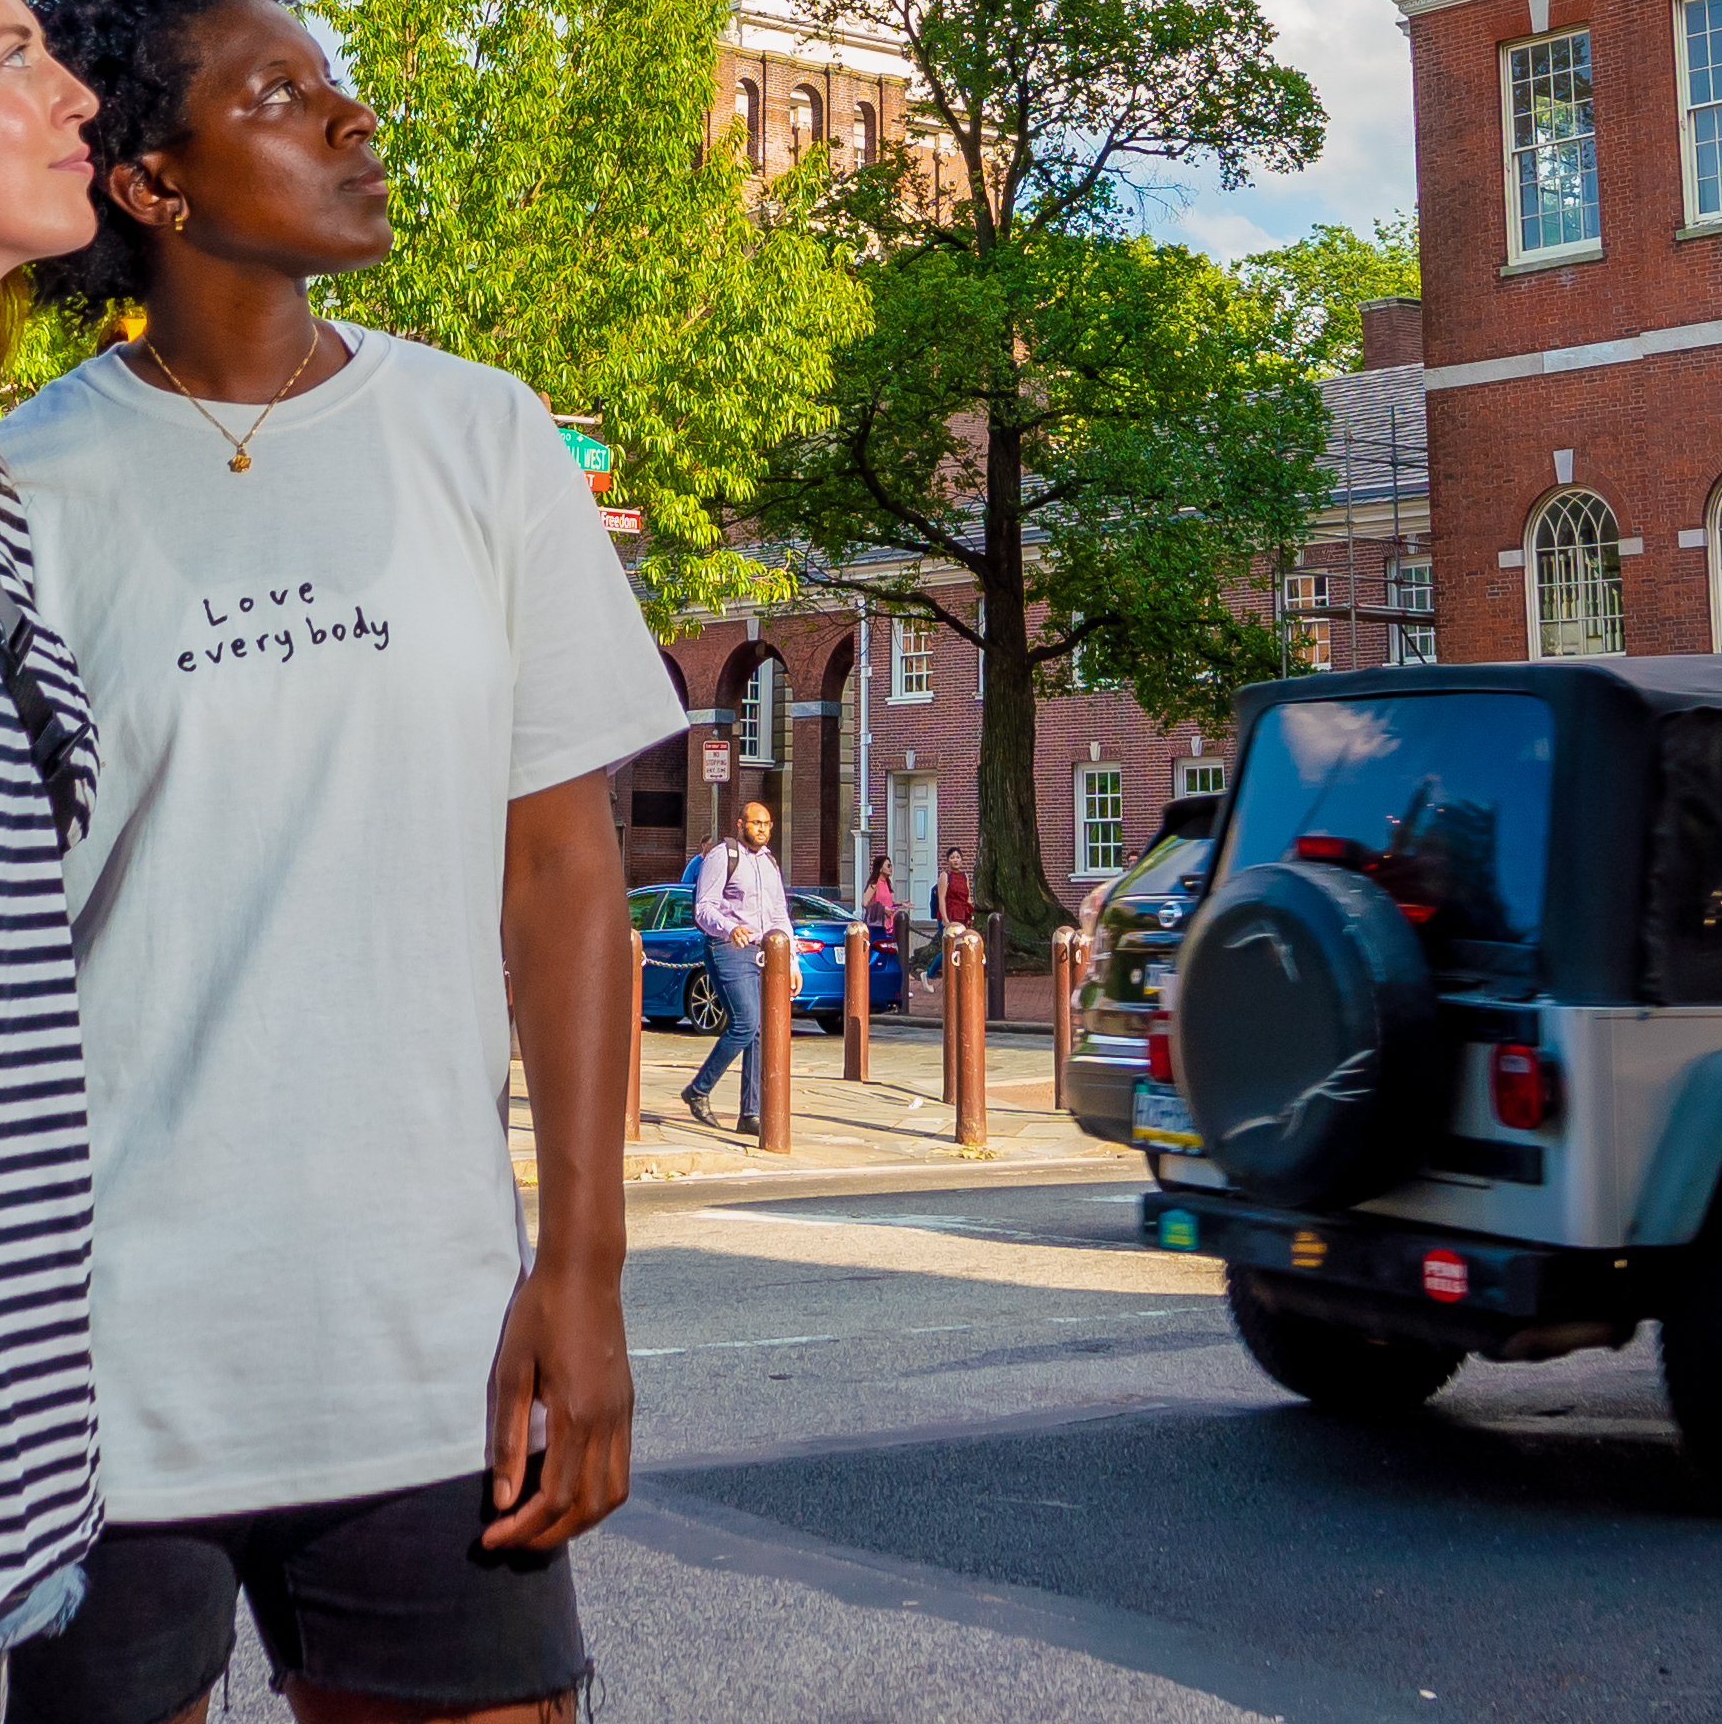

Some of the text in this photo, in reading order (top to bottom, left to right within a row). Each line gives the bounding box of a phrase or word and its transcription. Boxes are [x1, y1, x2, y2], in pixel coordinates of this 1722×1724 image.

[584, 448, 606, 470] WEST
[601, 511, 638, 529] Freedom
[203, 582, 315, 626] Love
[177, 606, 389, 672] everybody
